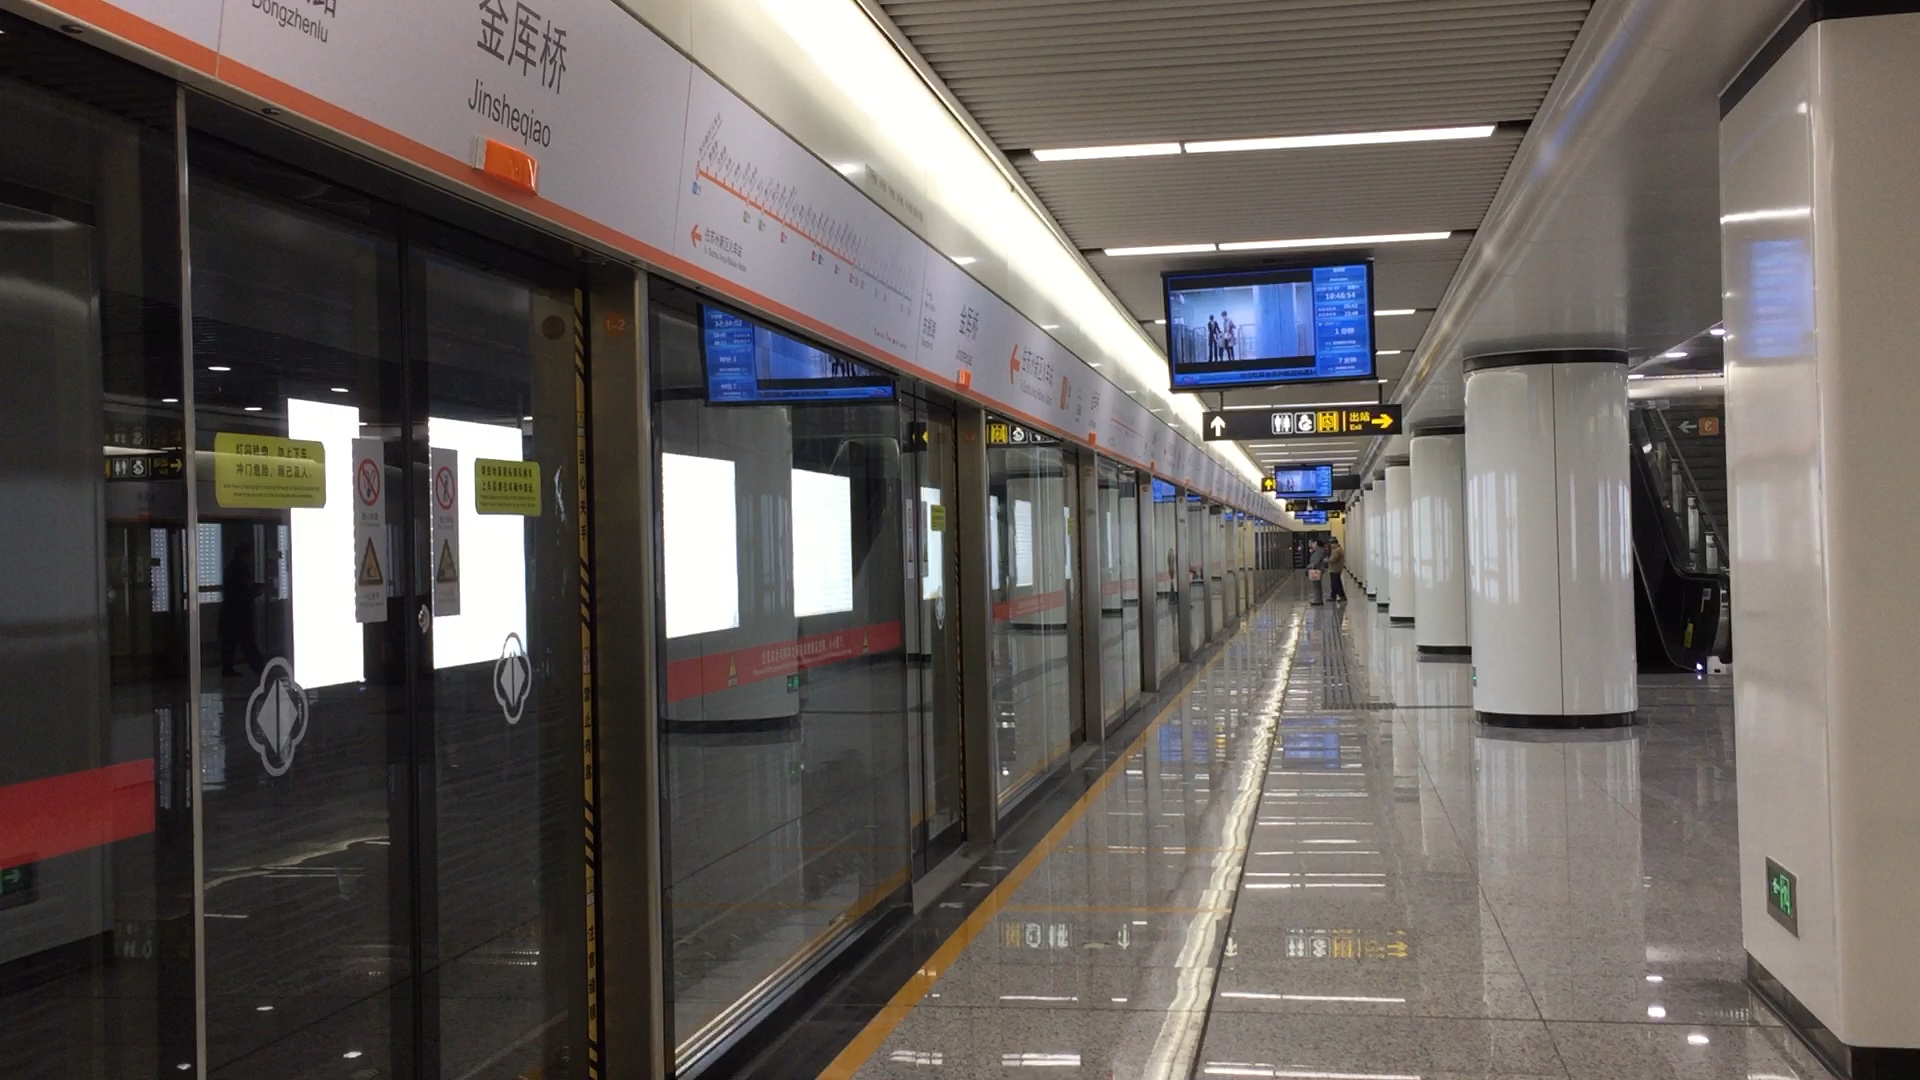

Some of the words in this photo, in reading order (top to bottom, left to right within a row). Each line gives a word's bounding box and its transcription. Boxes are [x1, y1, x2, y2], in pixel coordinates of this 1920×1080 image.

[468, 79, 552, 148] Jinsheqiao
[604, 319, 626, 331] 1-2
[1349, 411, 1370, 422] 出站
